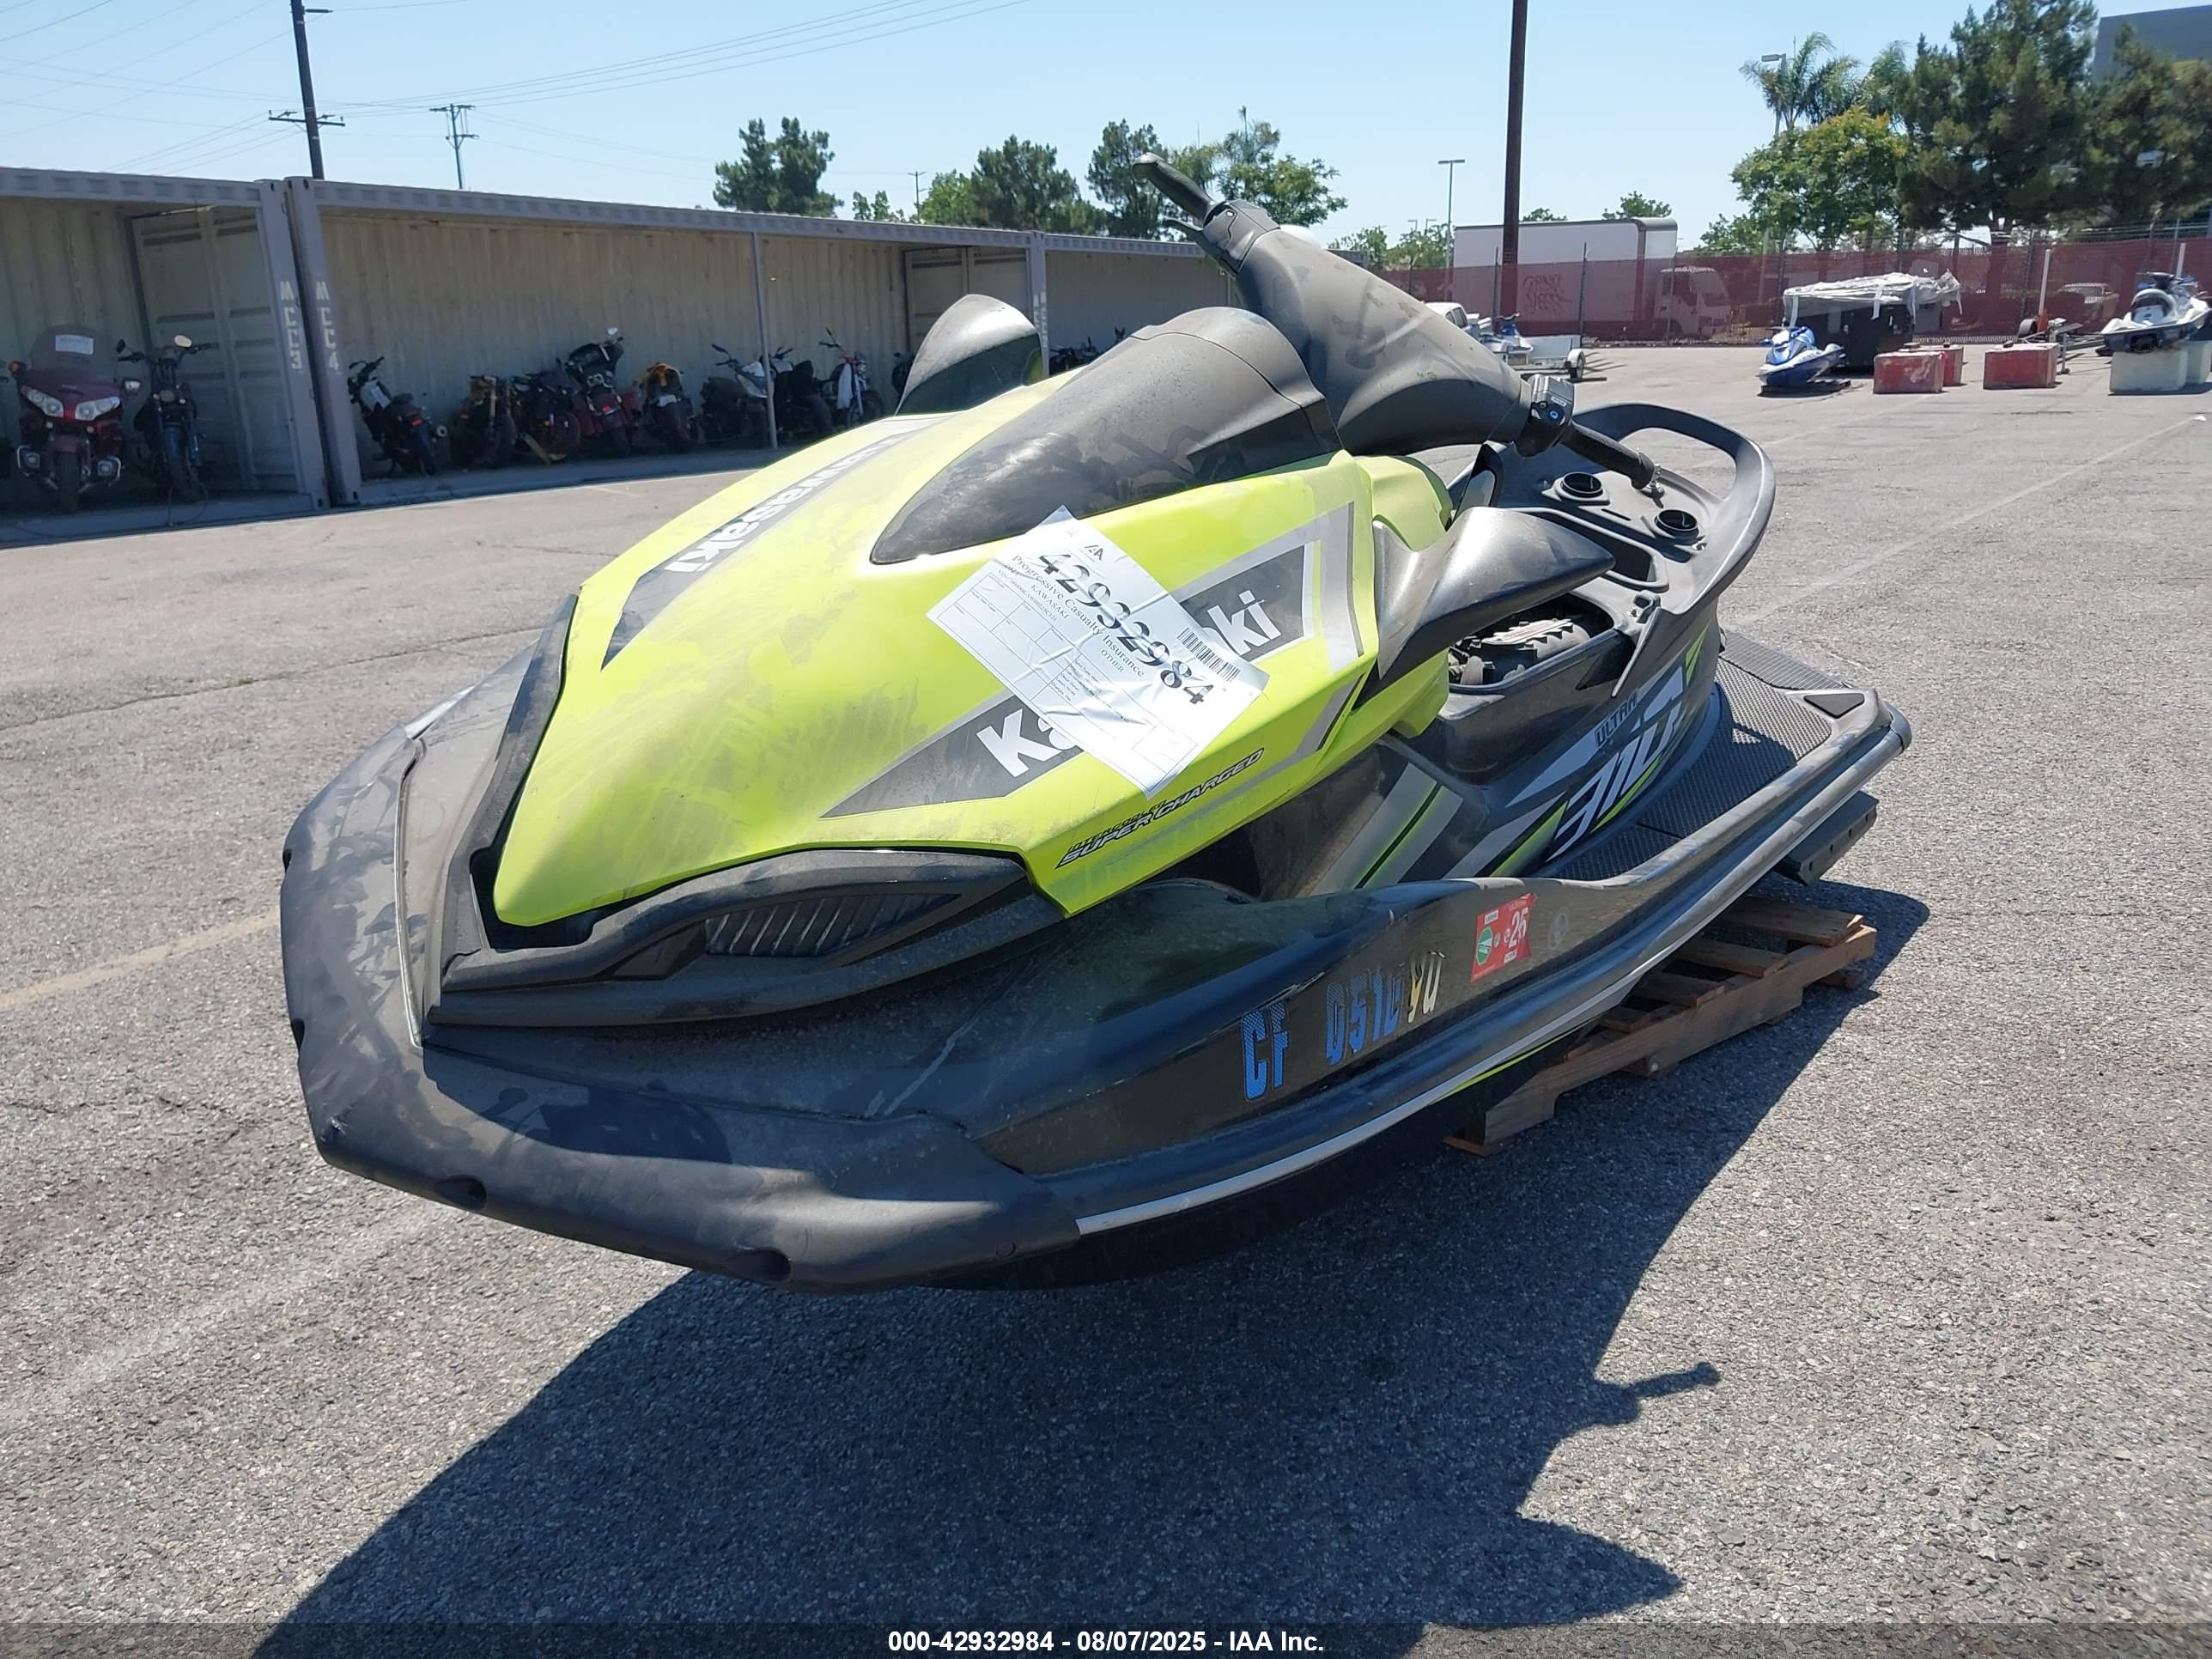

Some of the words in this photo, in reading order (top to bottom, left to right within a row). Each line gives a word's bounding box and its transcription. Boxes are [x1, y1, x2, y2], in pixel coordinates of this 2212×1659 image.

[280, 281, 302, 369] MCC3
[316, 281, 339, 371] MCC4
[1011, 554, 1065, 600] Progressive
[1064, 598, 1103, 635] Casualty
[1103, 635, 1146, 677] Insurance
[1030, 583, 1070, 619] KAWASAKI
[1100, 648, 1125, 673] OTHER
[1038, 554, 1214, 705] 42932984
[1546, 666, 1684, 862] 310
[1595, 690, 1641, 749] ULTRA
[1055, 813, 1153, 869] SUPER
[1153, 747, 1265, 820] CHARGED
[1241, 996, 1291, 1101] CF
